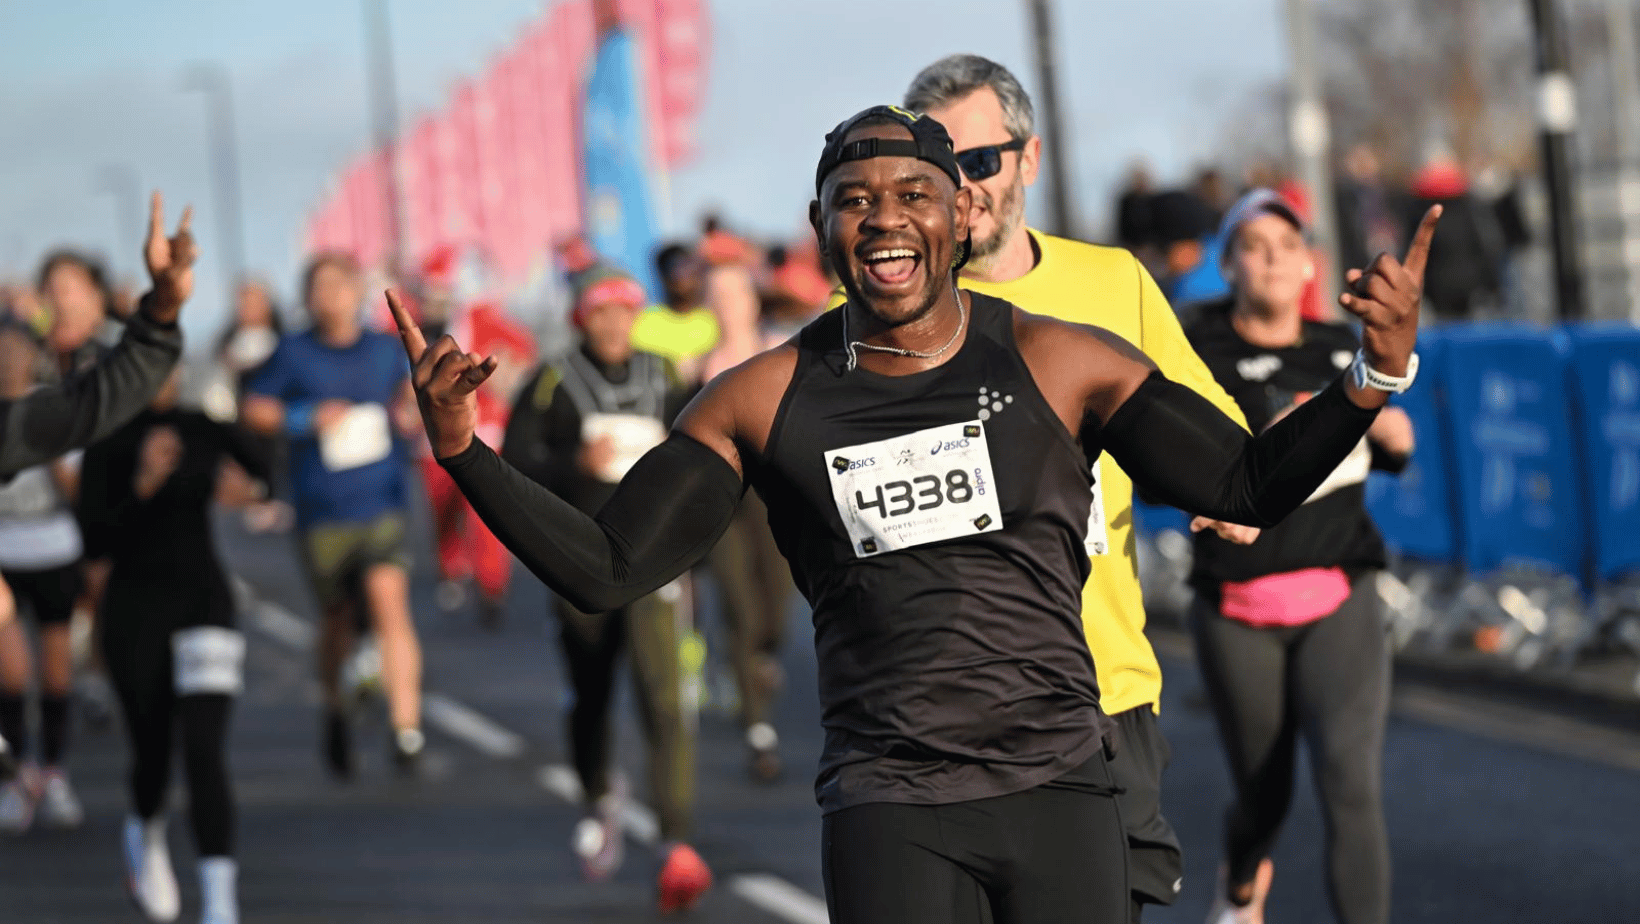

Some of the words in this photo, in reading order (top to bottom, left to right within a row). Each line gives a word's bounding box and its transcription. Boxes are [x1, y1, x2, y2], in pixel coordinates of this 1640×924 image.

[849, 456, 876, 470] asics
[855, 468, 973, 519] 4338
[974, 467, 986, 496] alpro
